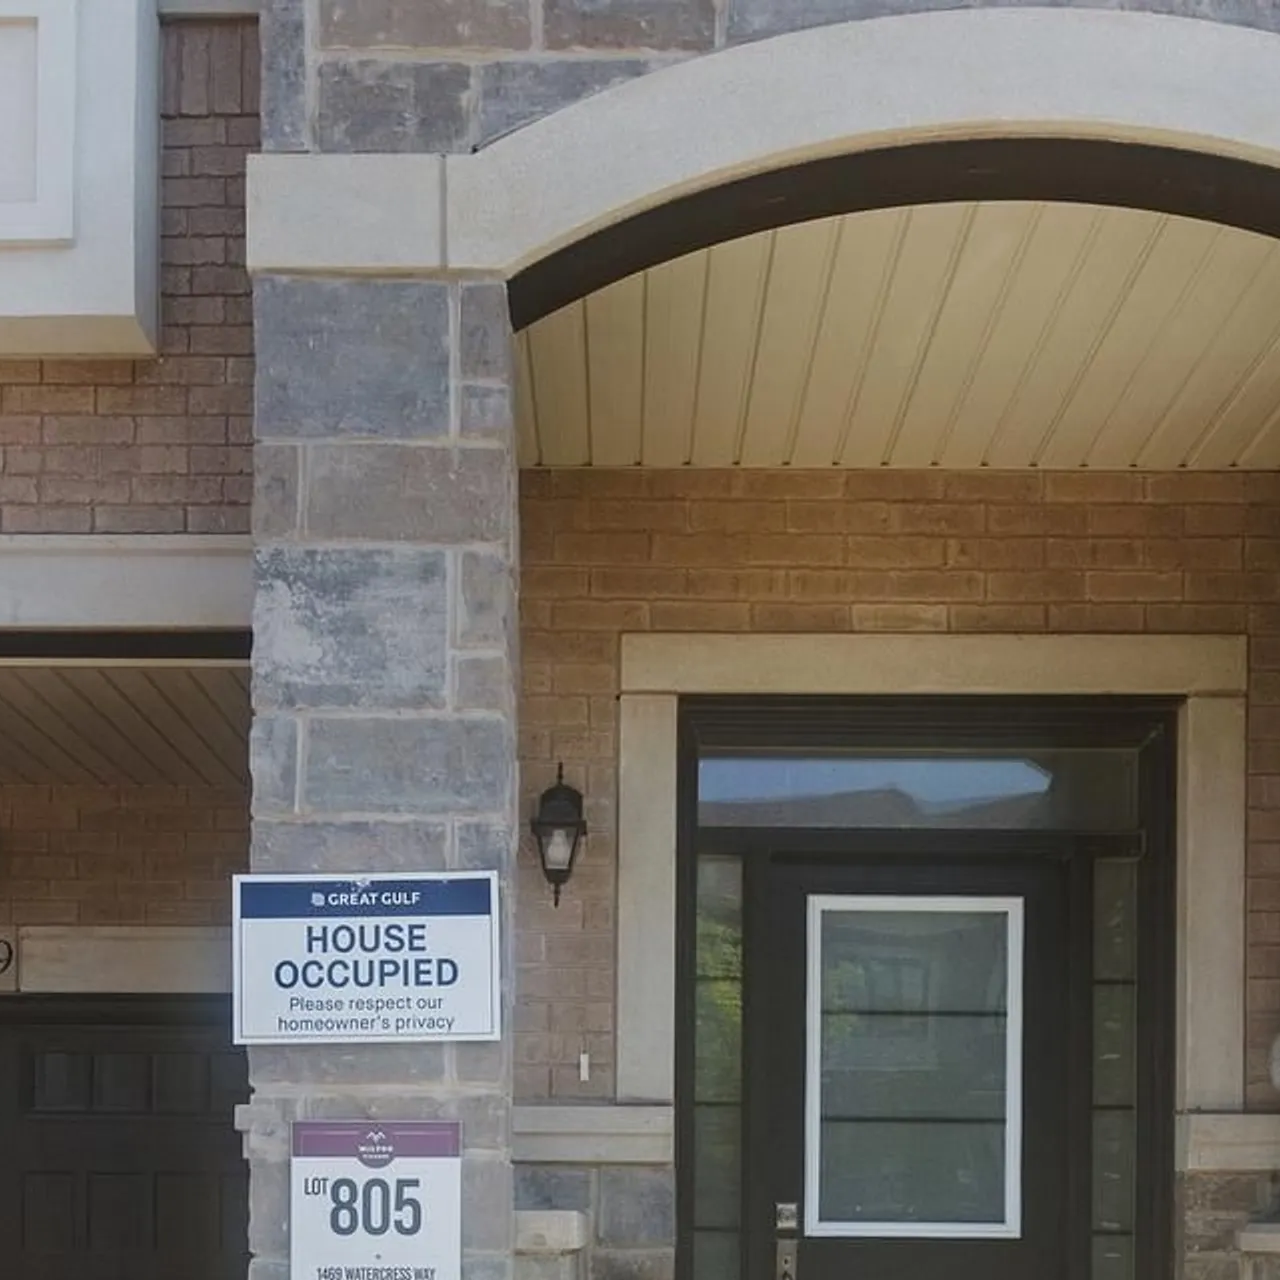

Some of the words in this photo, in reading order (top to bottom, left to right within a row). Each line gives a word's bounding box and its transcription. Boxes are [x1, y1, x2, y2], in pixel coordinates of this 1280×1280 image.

[328, 892, 378, 906] GREAT
[381, 891, 421, 905] GULF
[306, 923, 427, 953] HOUSE
[274, 958, 459, 989] OCCUPIED
[289, 996, 345, 1012] Please
[348, 997, 412, 1013] respect
[416, 998, 443, 1010] our
[278, 1015, 391, 1032] homeowner's
[396, 1014, 456, 1032] privacy
[303, 1177, 329, 1196] LOT
[330, 1177, 423, 1236] 805
[316, 1266, 343, 1280] 1469
[344, 1266, 413, 1280] WATERCRESS
[413, 1267, 436, 1280] WAY
